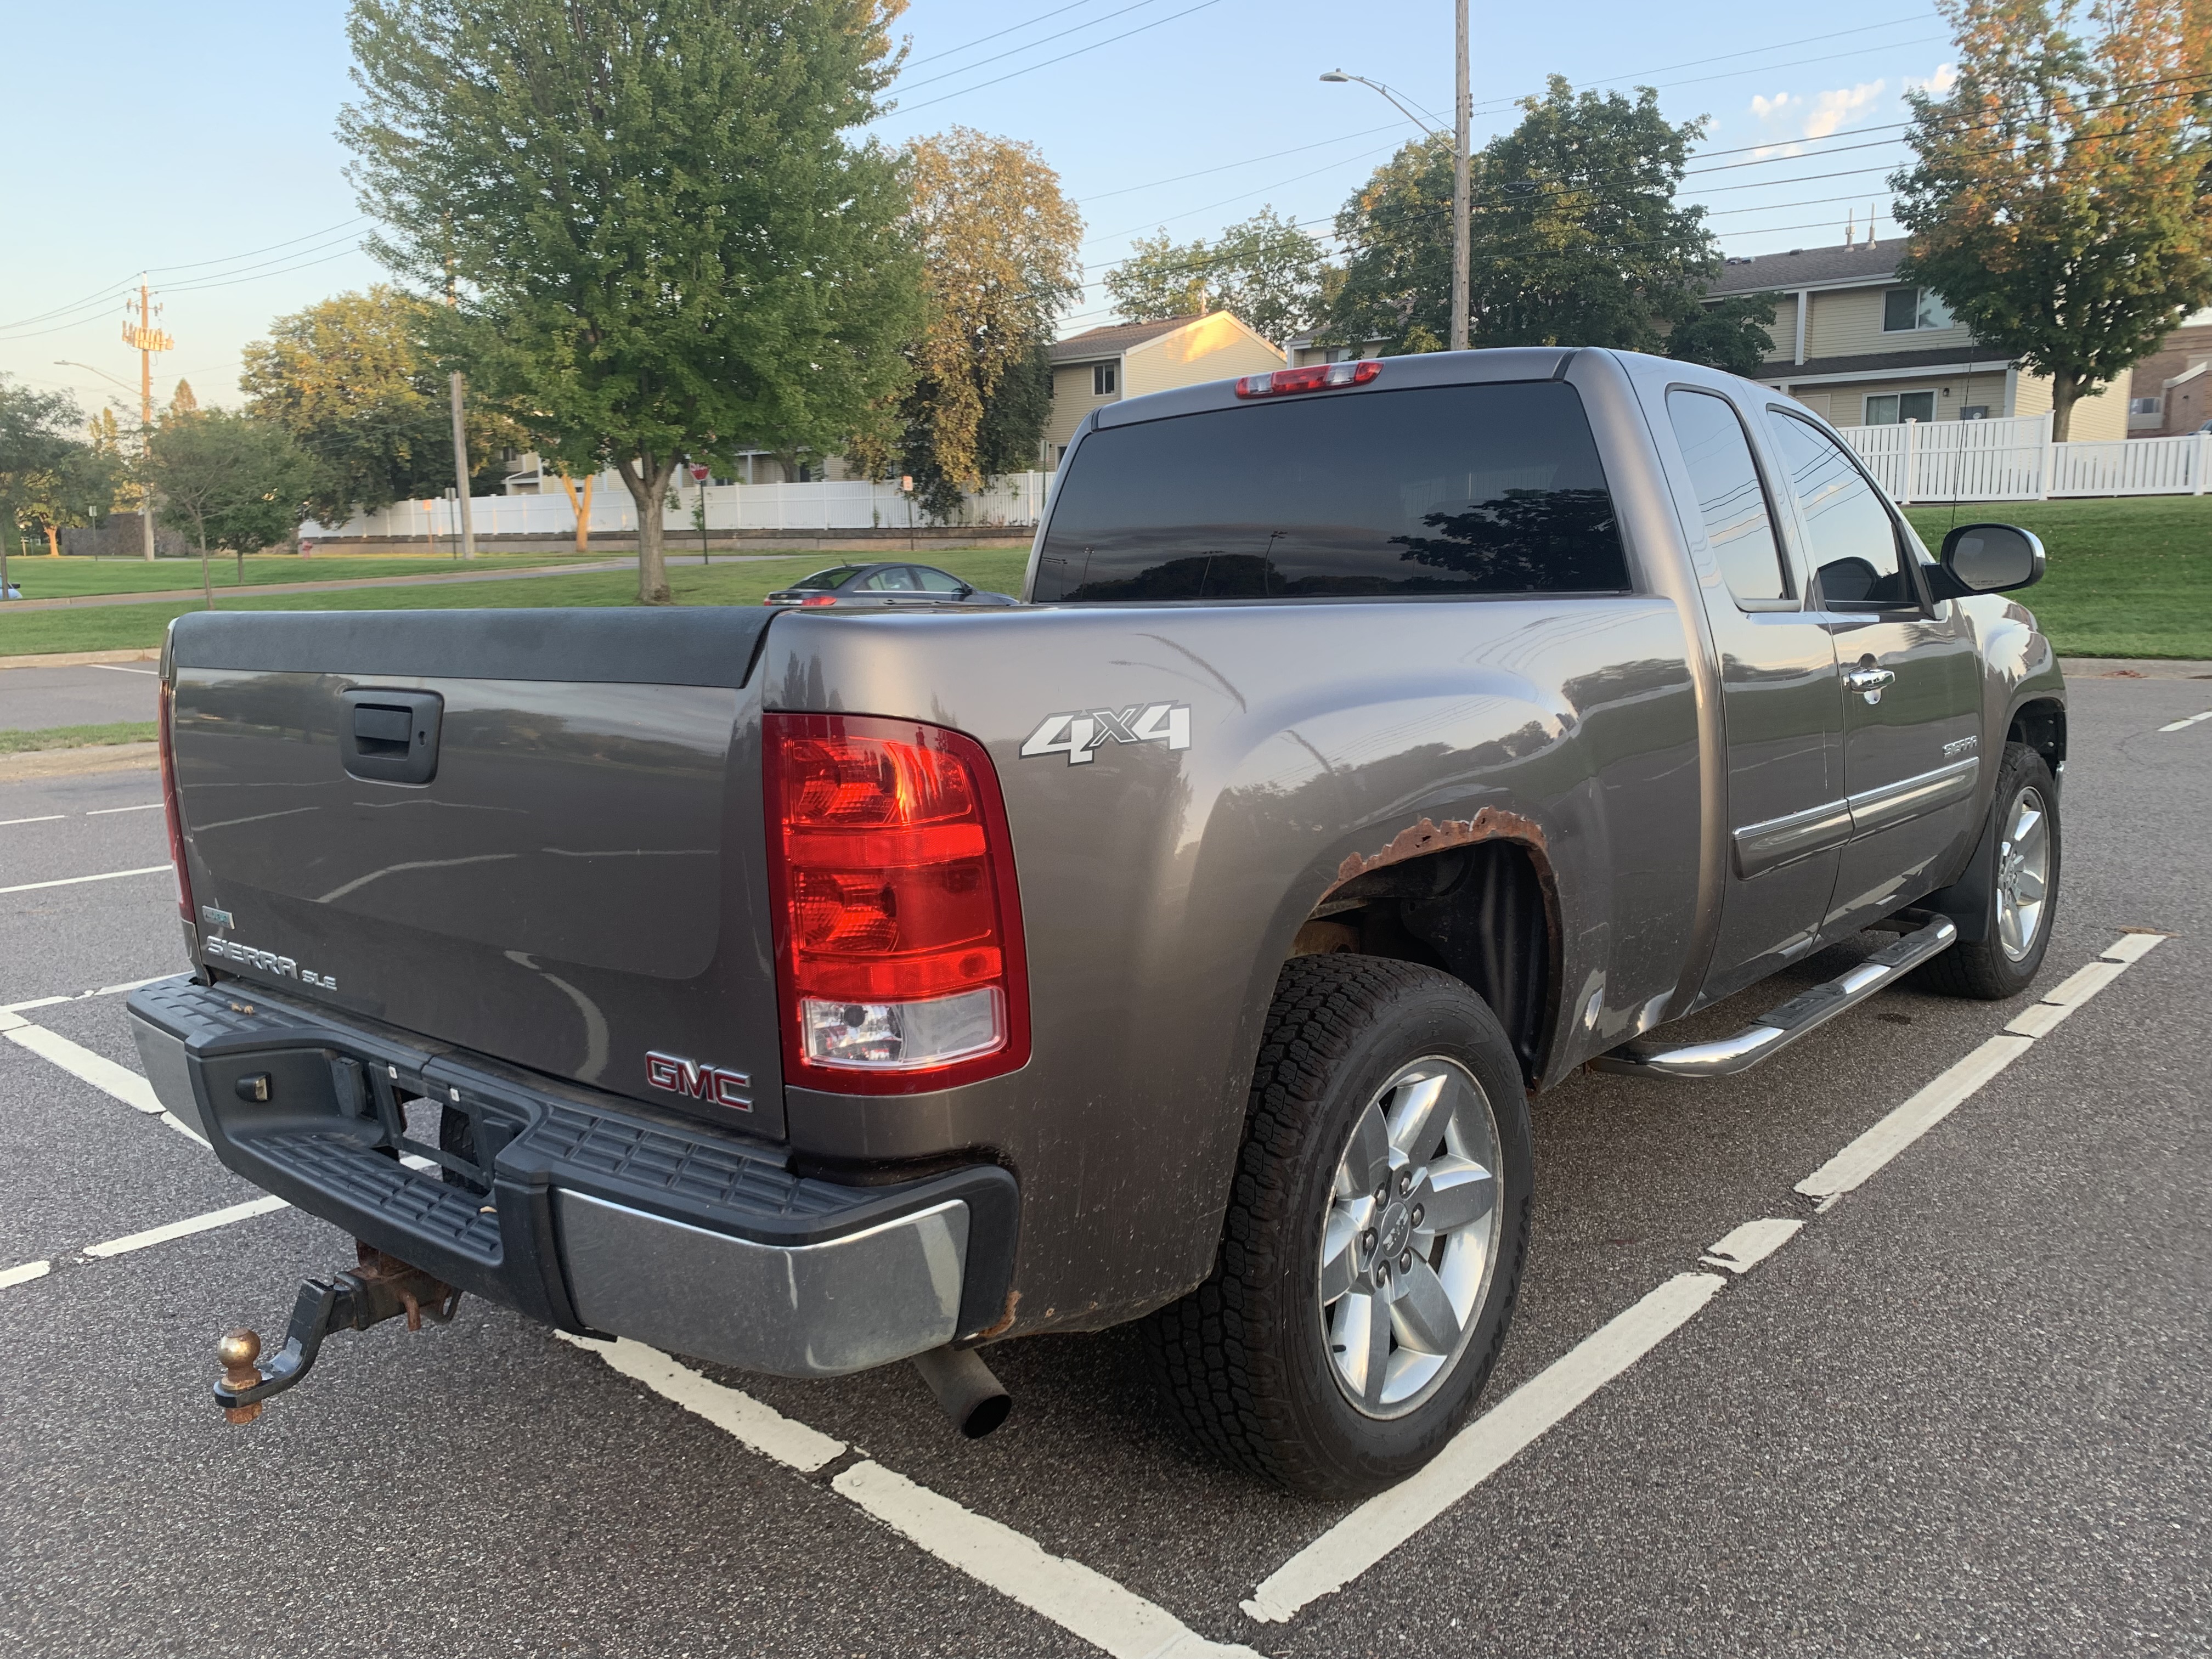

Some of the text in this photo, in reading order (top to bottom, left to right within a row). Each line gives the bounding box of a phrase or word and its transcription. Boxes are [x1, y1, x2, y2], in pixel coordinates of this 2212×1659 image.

[207, 935, 337, 991] SIERRA SLE
[645, 1050, 754, 1113] GMC
